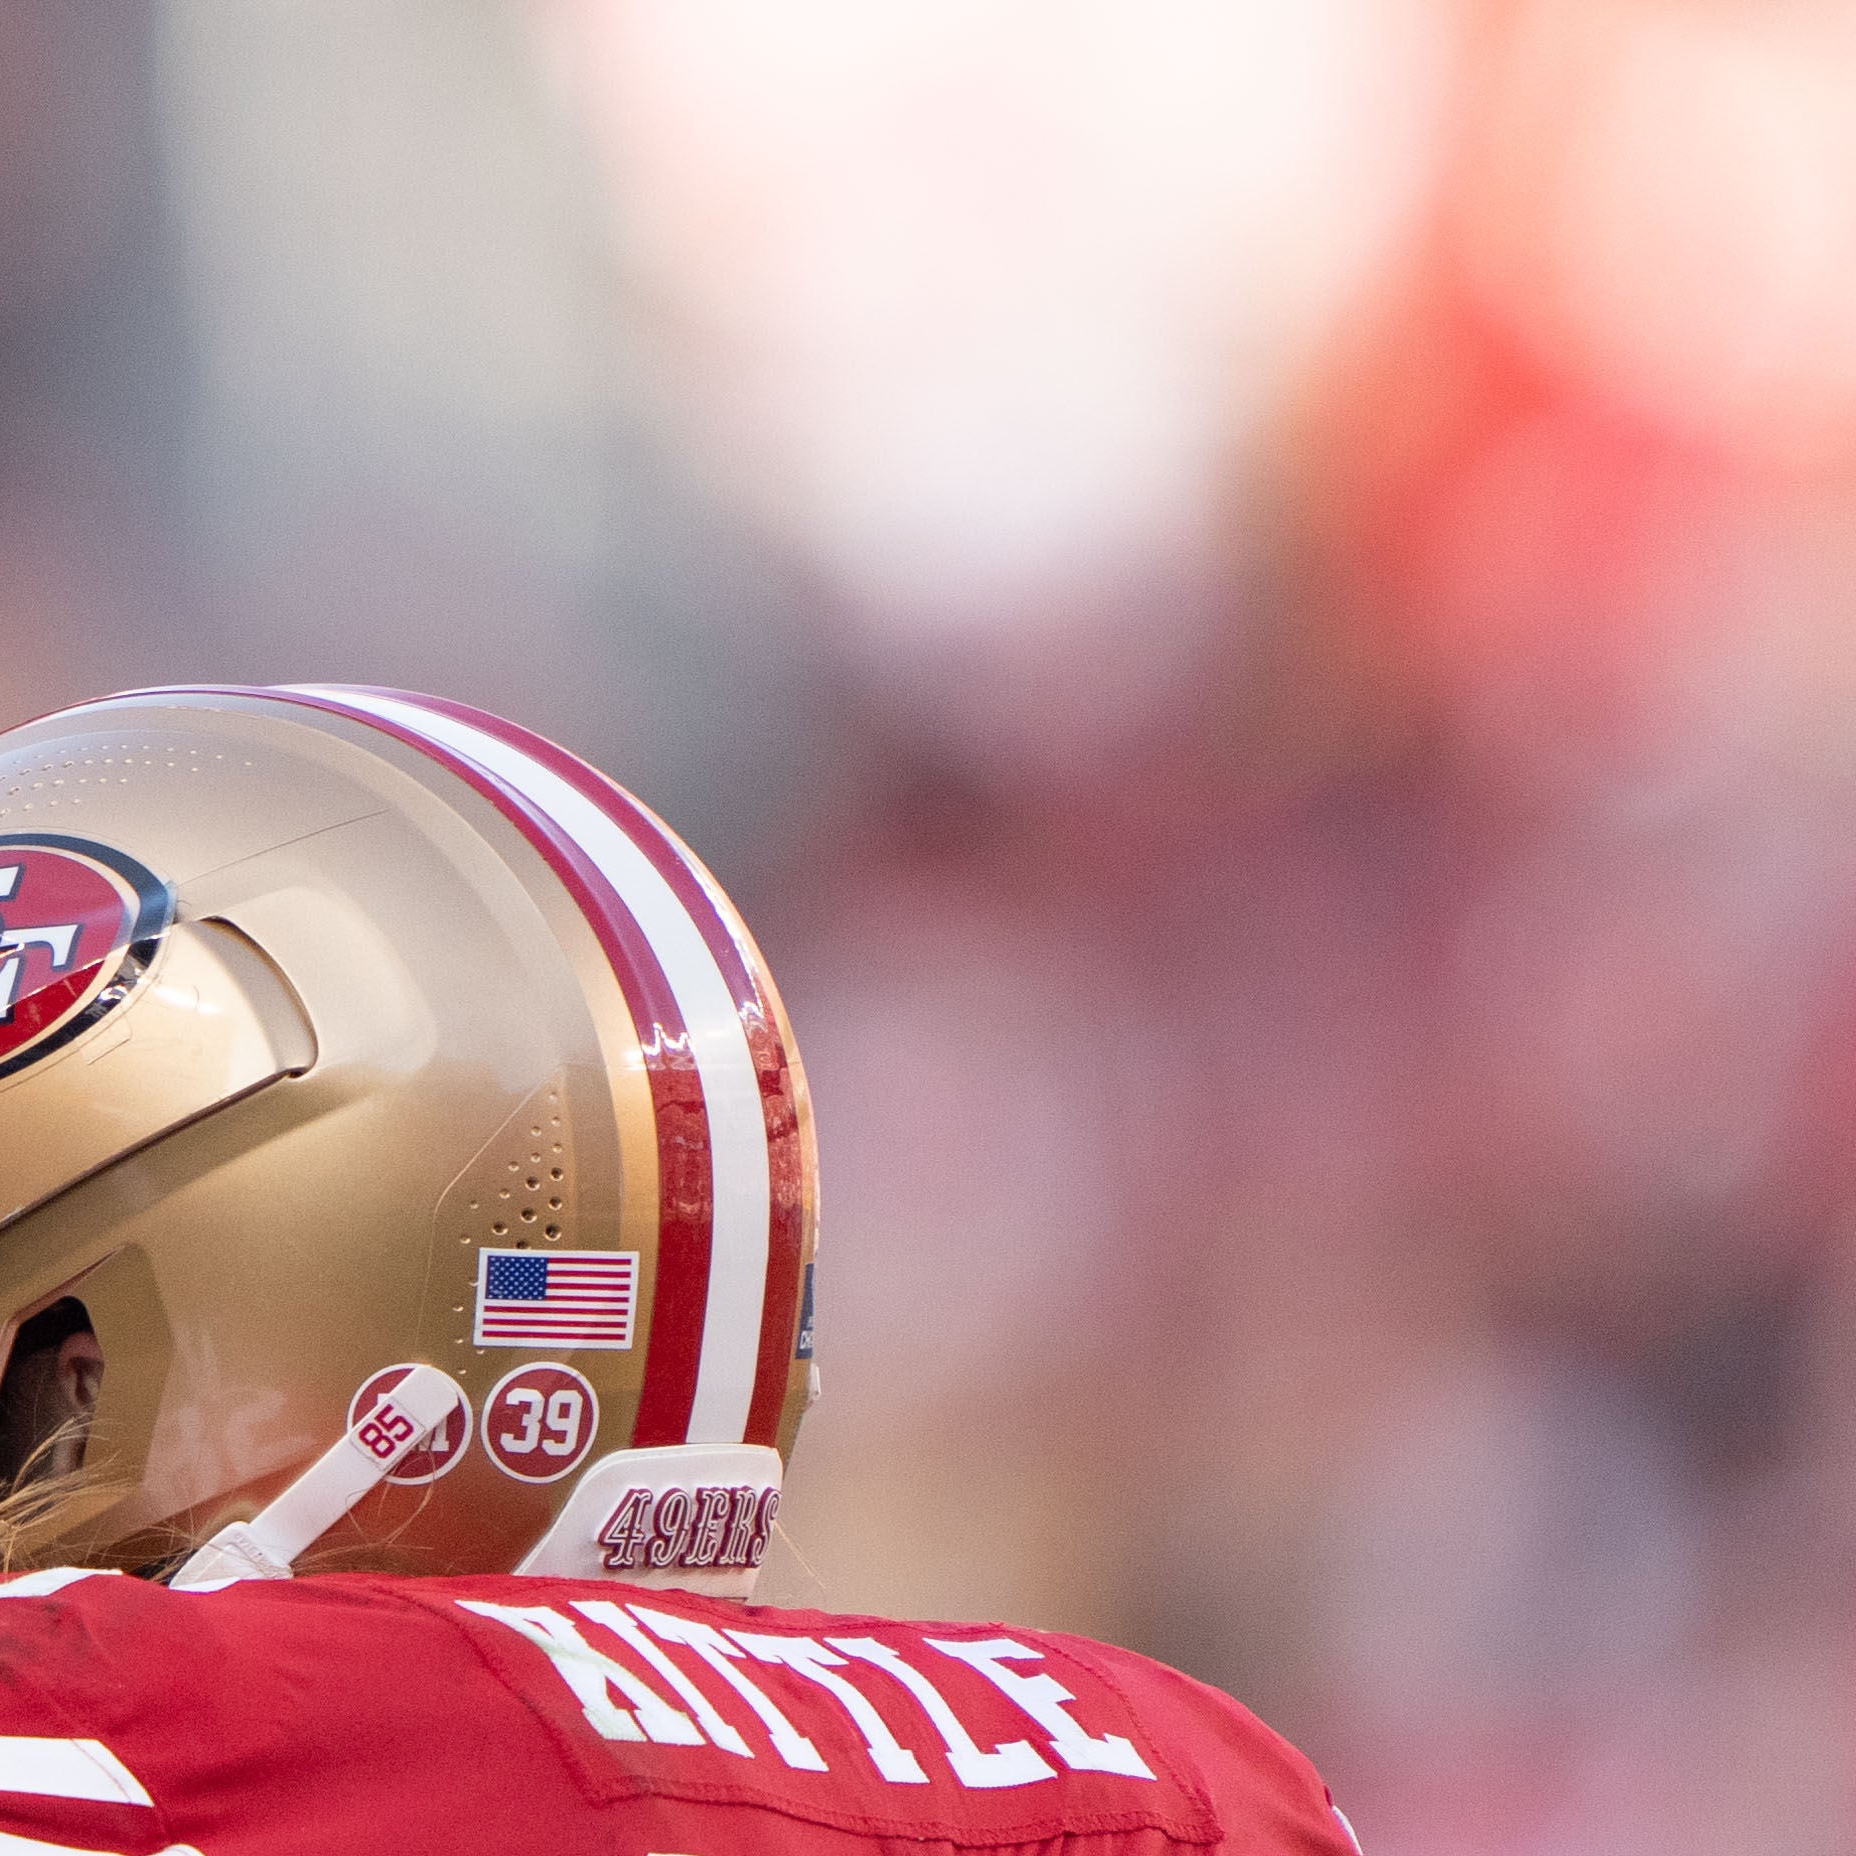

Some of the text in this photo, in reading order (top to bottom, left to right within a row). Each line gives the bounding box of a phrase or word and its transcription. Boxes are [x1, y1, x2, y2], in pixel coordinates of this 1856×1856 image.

[358, 1403, 415, 1459] 85
[499, 1387, 584, 1457] 39
[597, 1484, 783, 1571] 49ERS
[455, 1599, 1157, 1789] KITTLE
